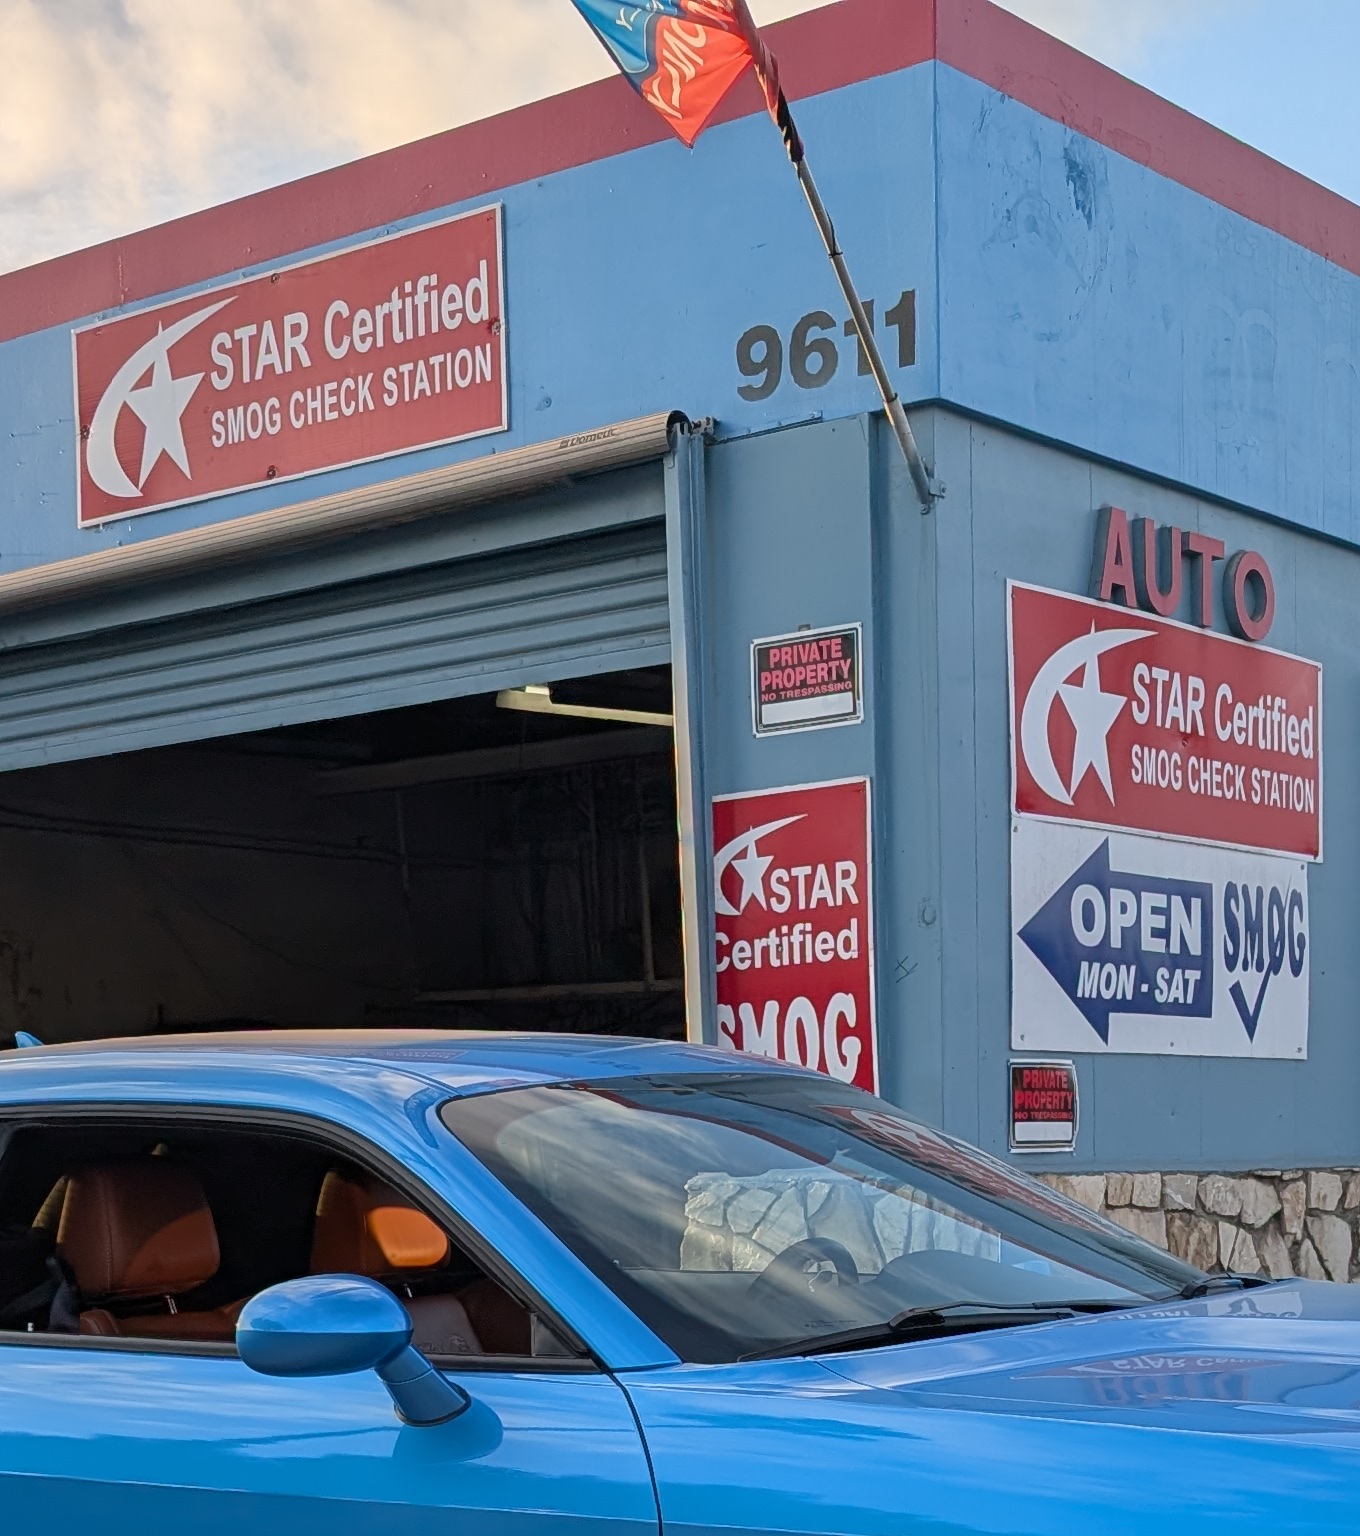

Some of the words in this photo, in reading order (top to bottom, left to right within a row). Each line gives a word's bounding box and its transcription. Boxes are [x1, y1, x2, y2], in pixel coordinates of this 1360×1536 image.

[210, 311, 312, 391] STAR
[324, 259, 489, 360] Certified
[736, 288, 916, 402] 9611
[211, 397, 282, 448] SMOG
[289, 372, 375, 430] CHECK
[382, 343, 492, 407] STATION
[1092, 506, 1275, 641] AUTO
[761, 658, 852, 692] PROPERTY
[769, 638, 843, 668] PRIVATE
[761, 692, 777, 702] NO
[780, 681, 853, 700] TRESPASSING
[1131, 662, 1205, 737] STAR
[1215, 683, 1314, 759] Certified
[1131, 744, 1182, 791] SMOG
[1188, 755, 1247, 802] CHECK
[1251, 767, 1315, 814] STATION
[769, 860, 859, 913] STAR
[716, 917, 859, 973] Certified
[1070, 884, 1202, 956] OPEN
[1224, 881, 1307, 978] SMOG
[1077, 961, 1136, 1001] MON
[1155, 967, 1202, 1005] SAT
[1014, 1090, 1073, 1110] PROPERTY
[1023, 1069, 1068, 1089] PRIVATE
[1015, 1111, 1028, 1119] NO
